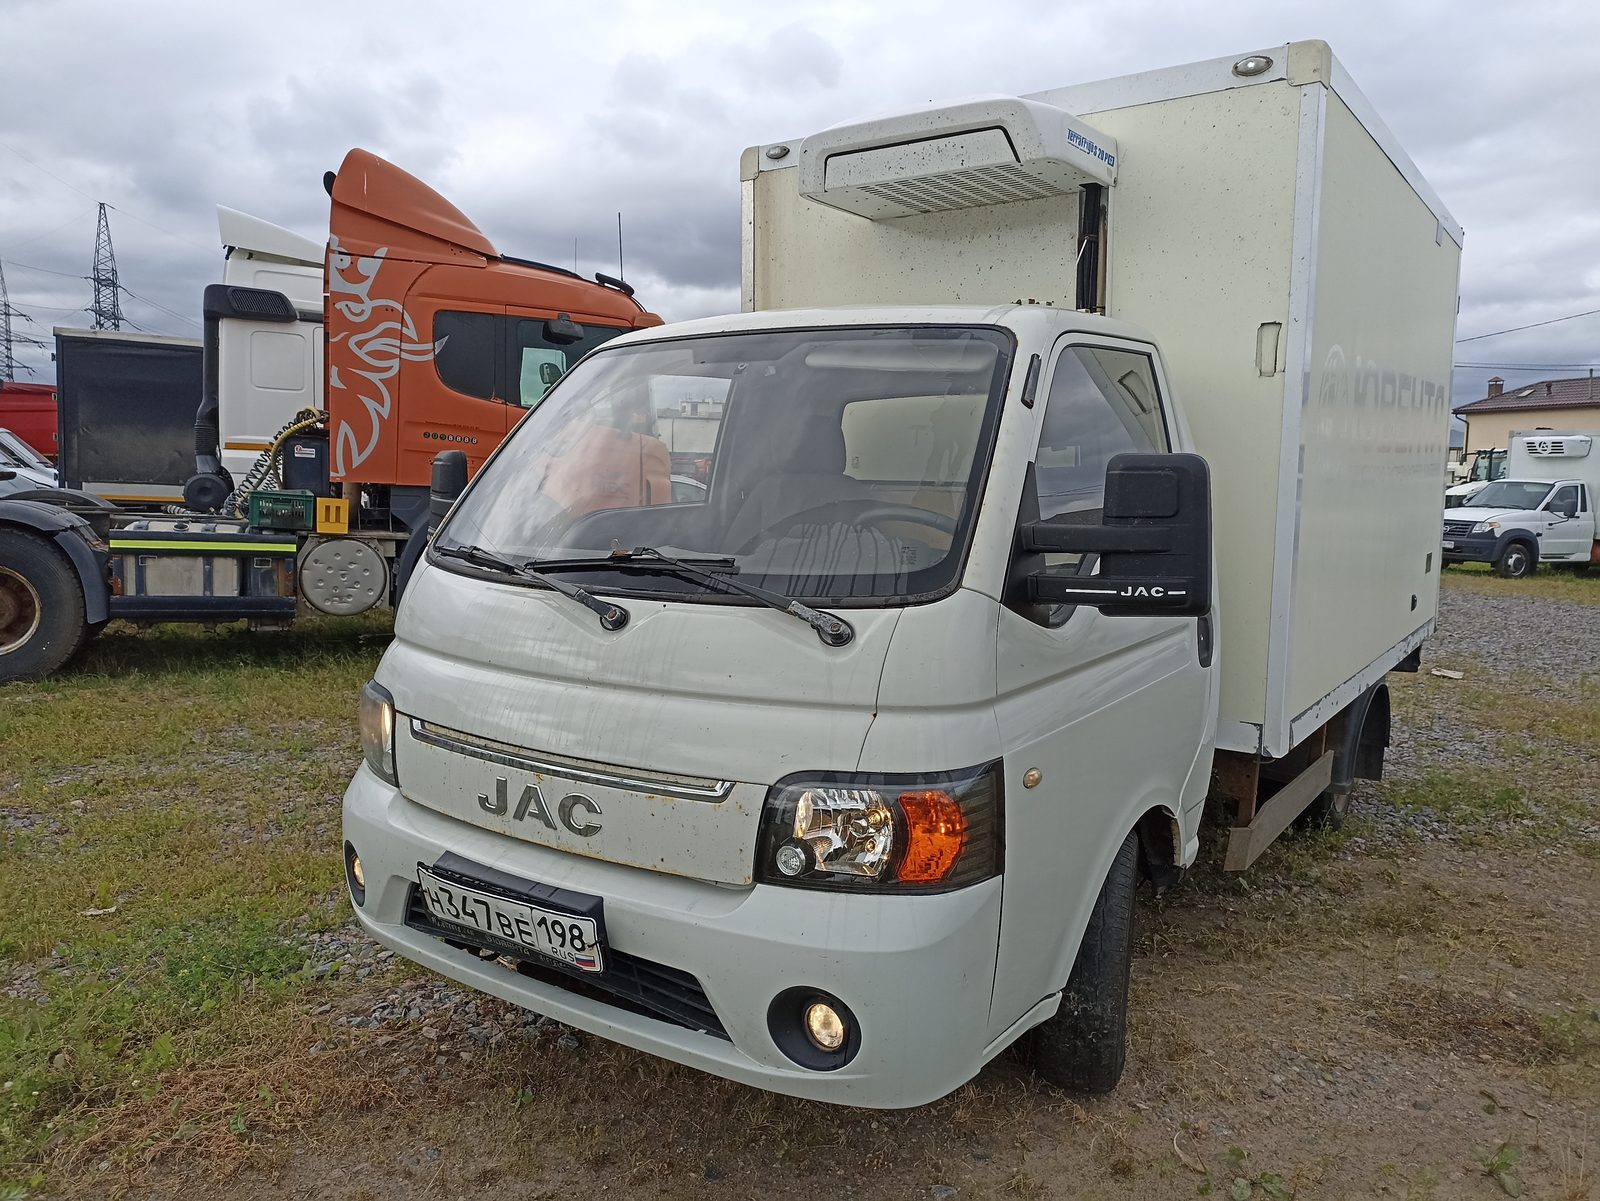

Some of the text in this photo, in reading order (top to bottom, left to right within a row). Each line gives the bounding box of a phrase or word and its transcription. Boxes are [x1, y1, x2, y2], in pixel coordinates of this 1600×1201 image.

[1120, 586, 1165, 597] JAC
[477, 775, 603, 838] JAC
[536, 915, 587, 952] 198
[552, 946, 575, 962] RUS
